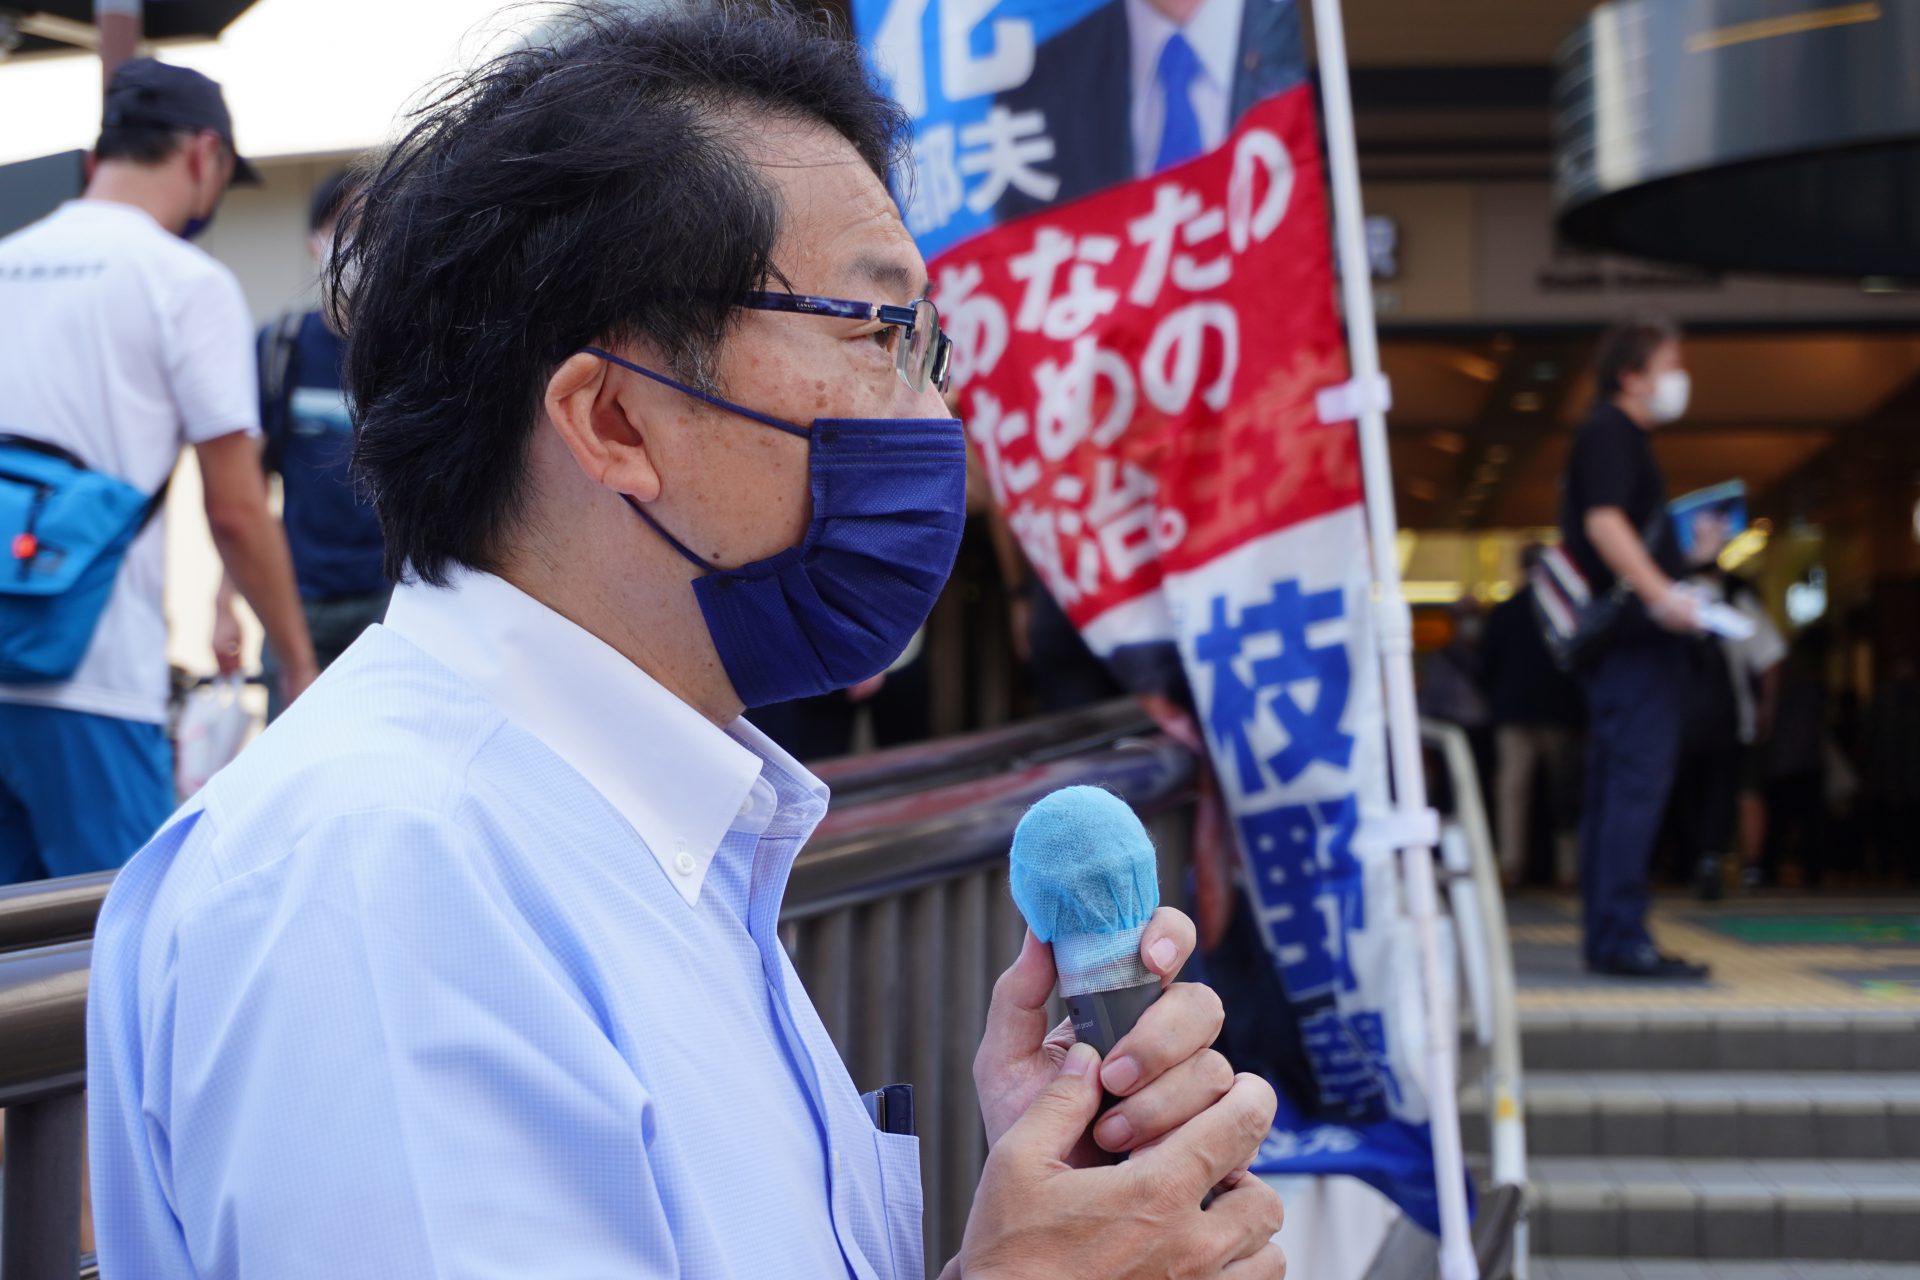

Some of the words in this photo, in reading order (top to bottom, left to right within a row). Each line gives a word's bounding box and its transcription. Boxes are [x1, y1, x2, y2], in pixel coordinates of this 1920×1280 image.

[928, 127, 1296, 388] あなたの
[967, 300, 1241, 507] ための
